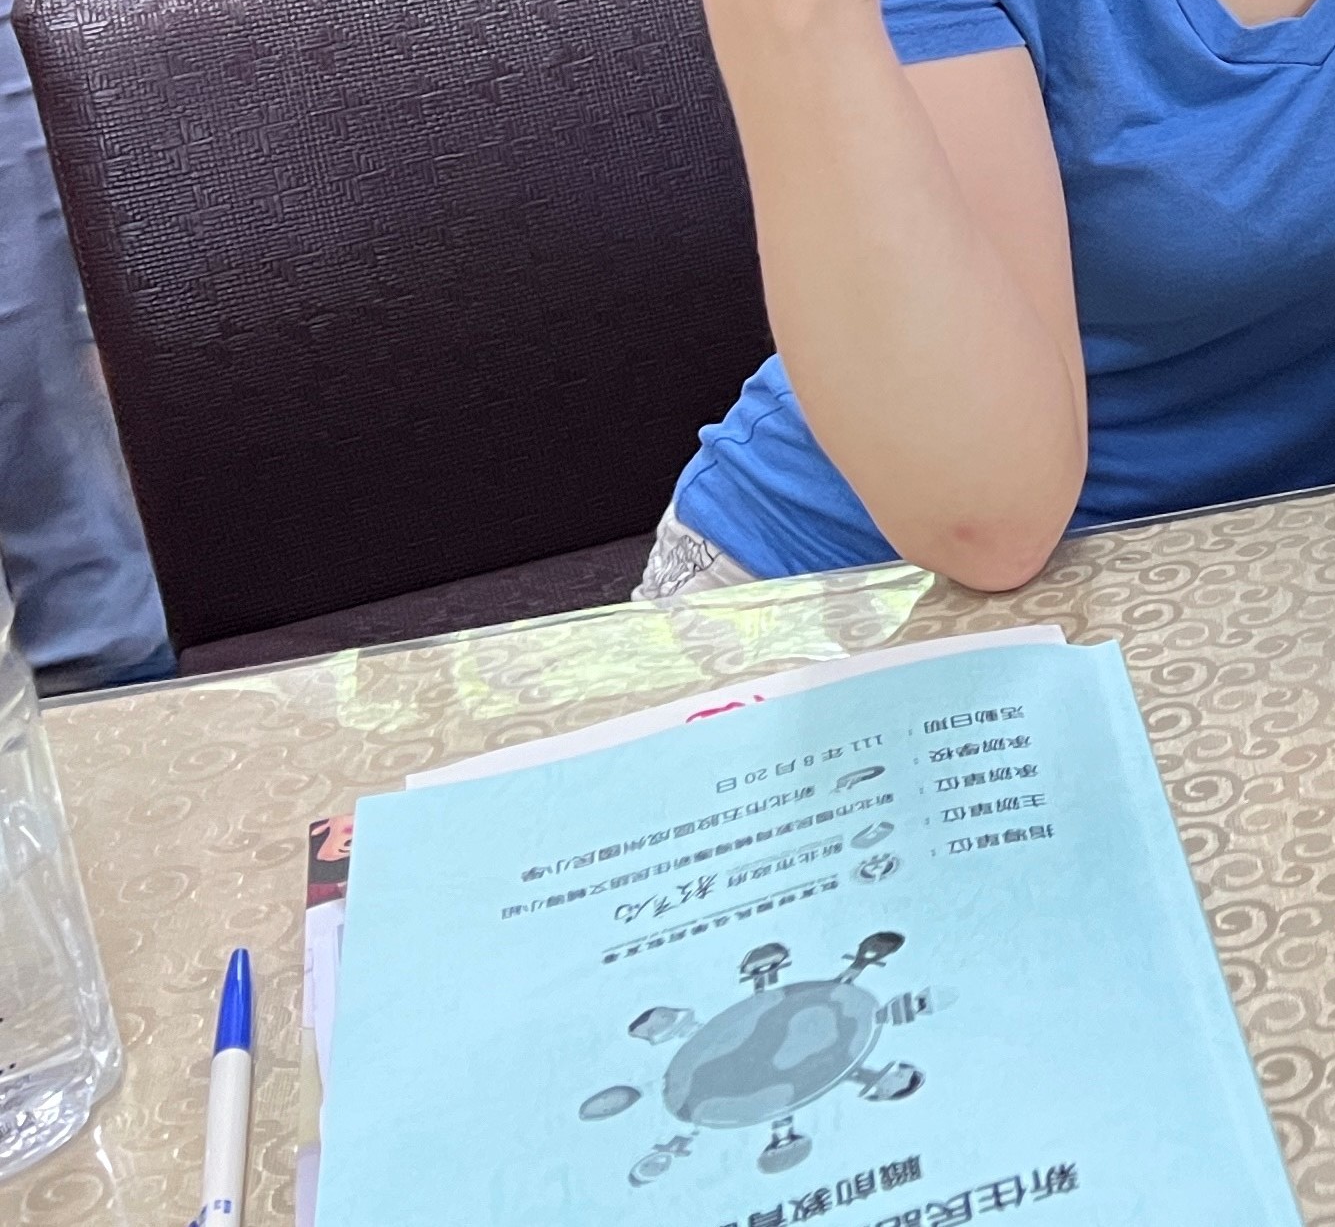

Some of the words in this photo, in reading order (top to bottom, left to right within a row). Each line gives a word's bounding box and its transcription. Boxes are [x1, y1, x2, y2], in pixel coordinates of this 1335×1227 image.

[520, 784, 817, 883] 新北市五股區成州國民小學
[727, 842, 844, 888] 新北市政府
[719, 1153, 922, 1227] 職前教育
